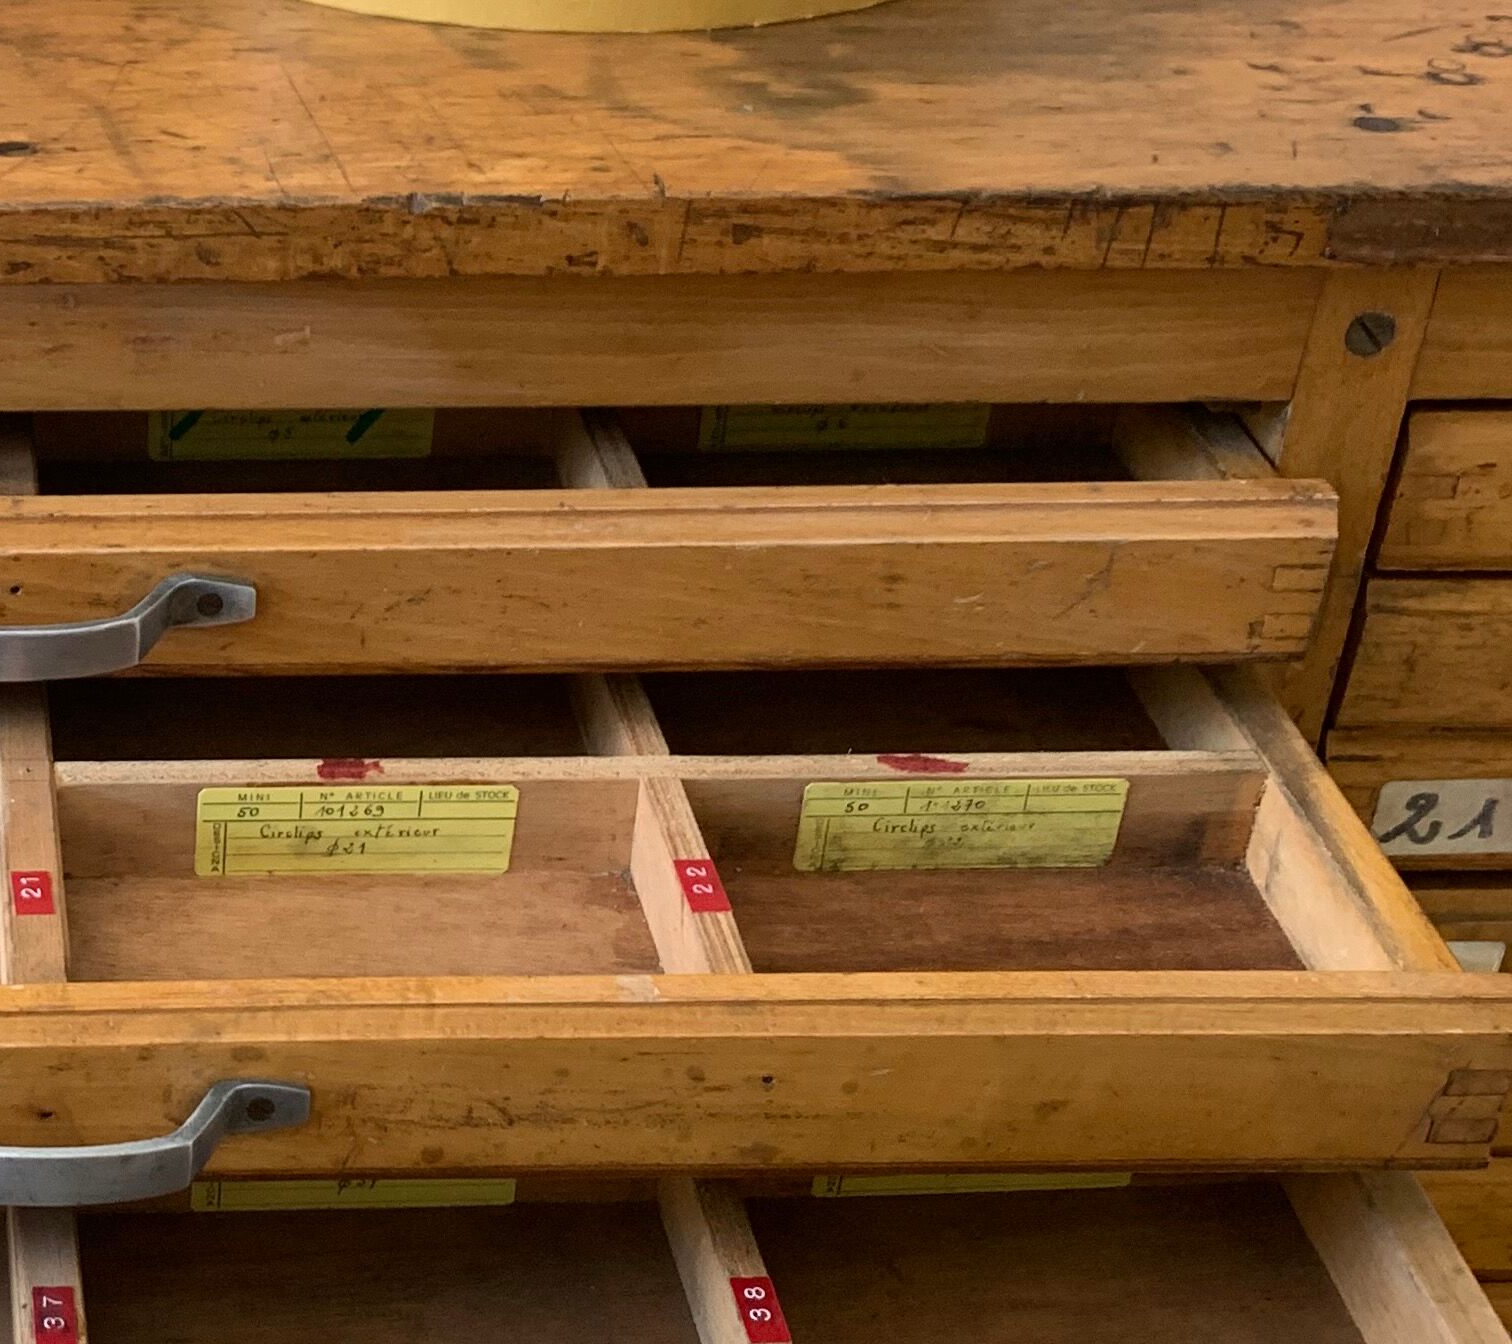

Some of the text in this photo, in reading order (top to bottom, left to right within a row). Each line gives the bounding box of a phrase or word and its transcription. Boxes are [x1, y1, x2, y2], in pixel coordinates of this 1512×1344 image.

[238, 793, 271, 801] MINI
[346, 791, 403, 800] ARTICLE
[428, 791, 453, 799] LIEU
[456, 791, 470, 799] de
[475, 790, 510, 799] STOCK
[1082, 784, 1117, 792] STOCK
[237, 807, 260, 817] 50
[844, 802, 869, 813] 50
[1377, 792, 1499, 845] 21
[20, 877, 42, 898] 21
[685, 866, 714, 894] 22
[42, 1296, 65, 1329] 37
[743, 1286, 772, 1321] 38
